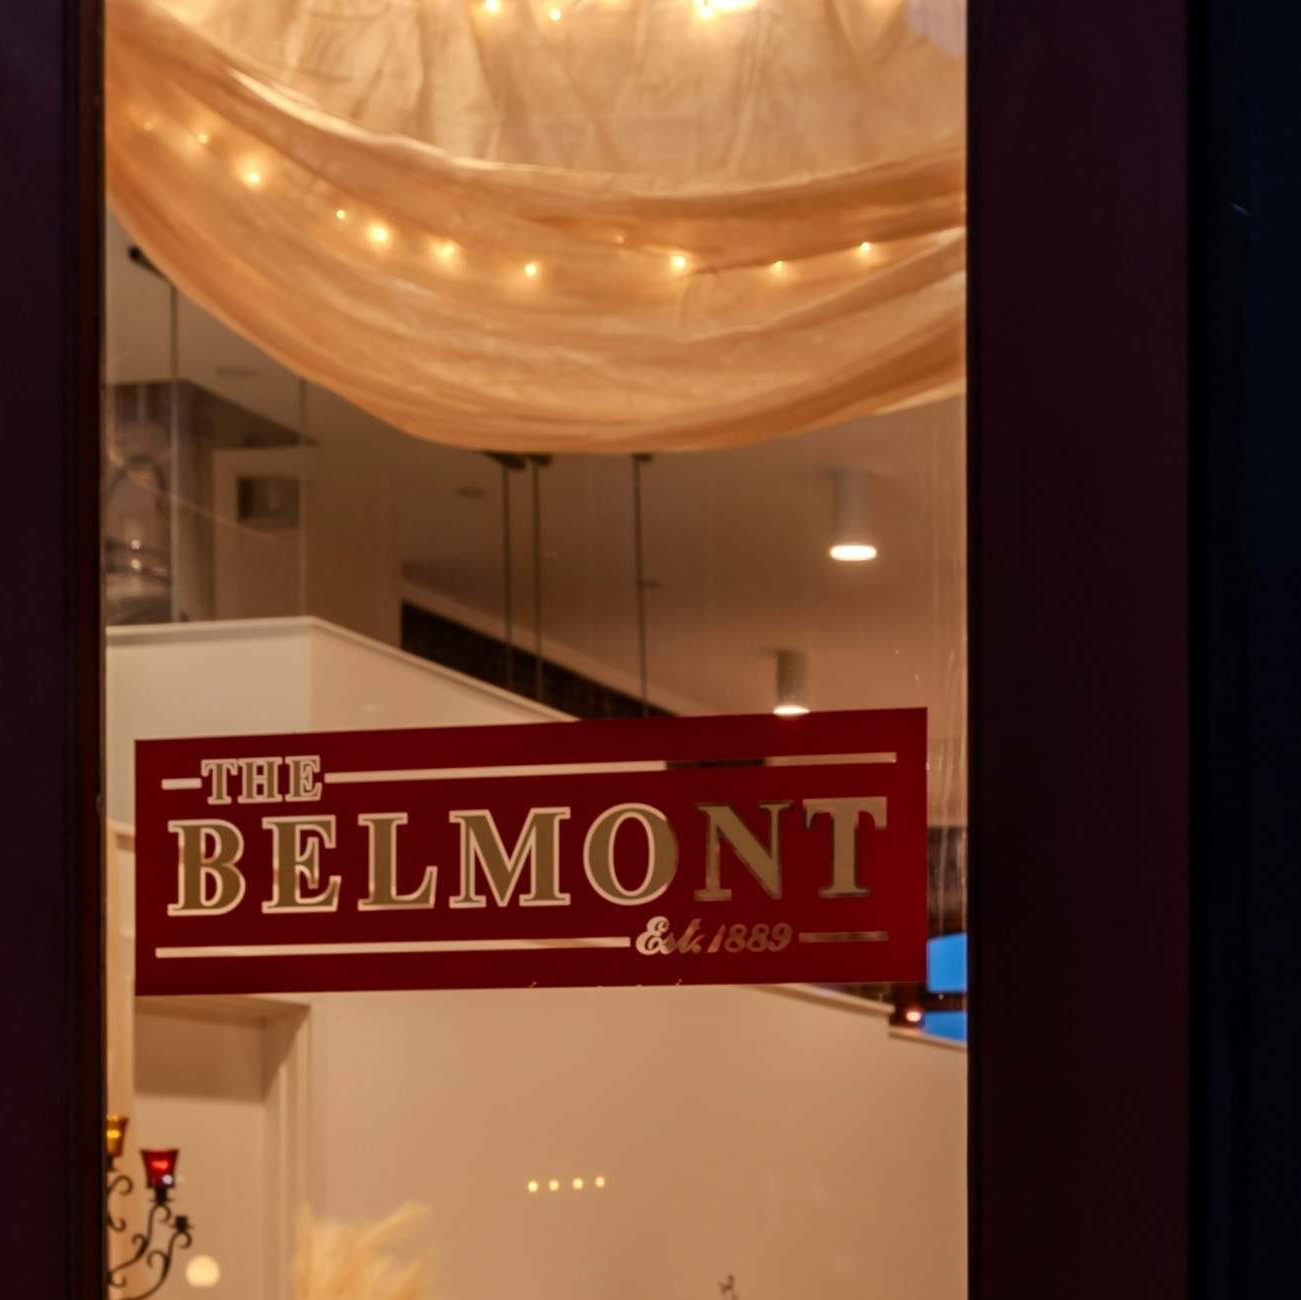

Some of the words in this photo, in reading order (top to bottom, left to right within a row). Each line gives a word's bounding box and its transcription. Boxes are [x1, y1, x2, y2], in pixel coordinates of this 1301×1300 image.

[201, 755, 323, 805] THE
[167, 796, 888, 917] BELMONT
[706, 922, 793, 954] 1889
